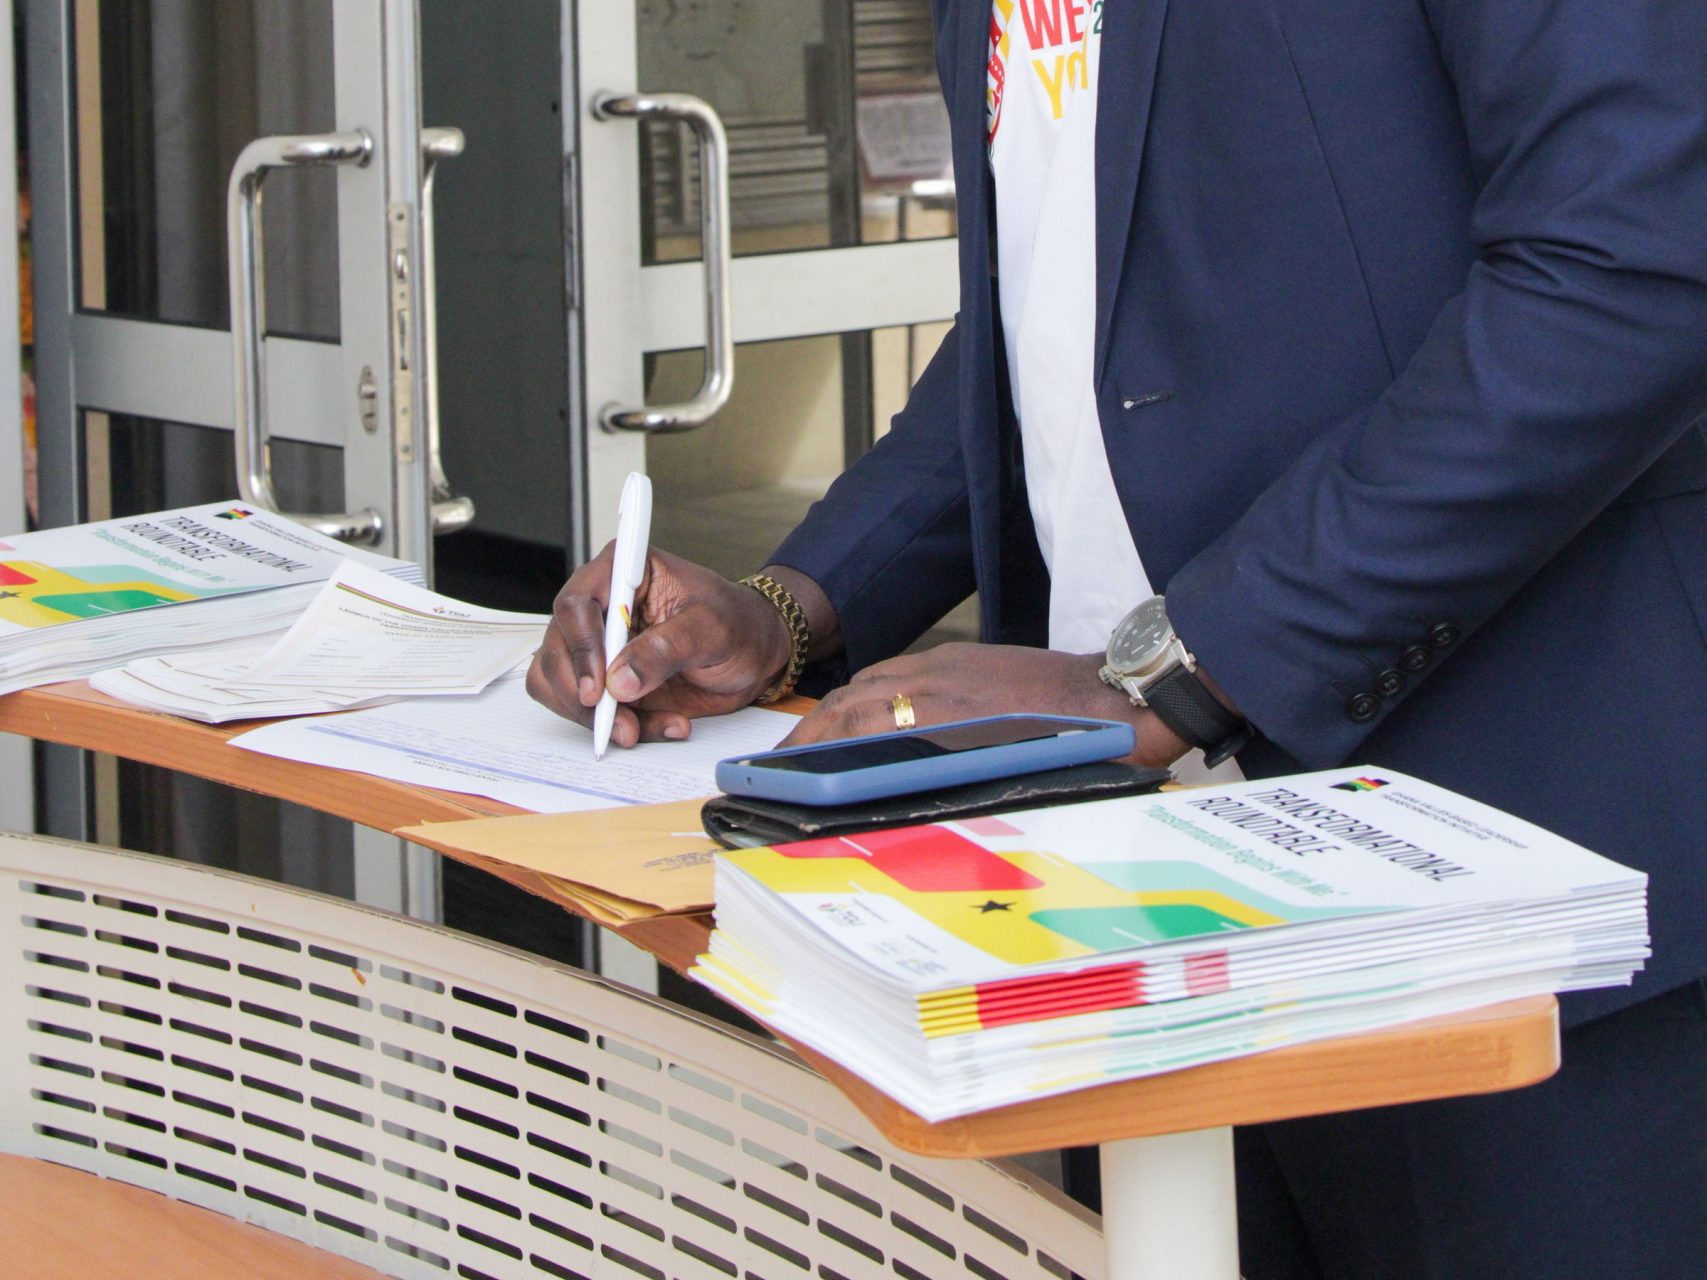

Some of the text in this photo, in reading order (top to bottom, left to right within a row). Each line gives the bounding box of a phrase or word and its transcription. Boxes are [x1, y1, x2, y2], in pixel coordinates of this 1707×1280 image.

[121, 522, 228, 561] ROUNDTABLE
[159, 516, 313, 573] TRANSFORMATIONAL
[1187, 796, 1343, 857] ROUNDTABLE
[1245, 787, 1476, 883] TRANSFORMATIONAL
